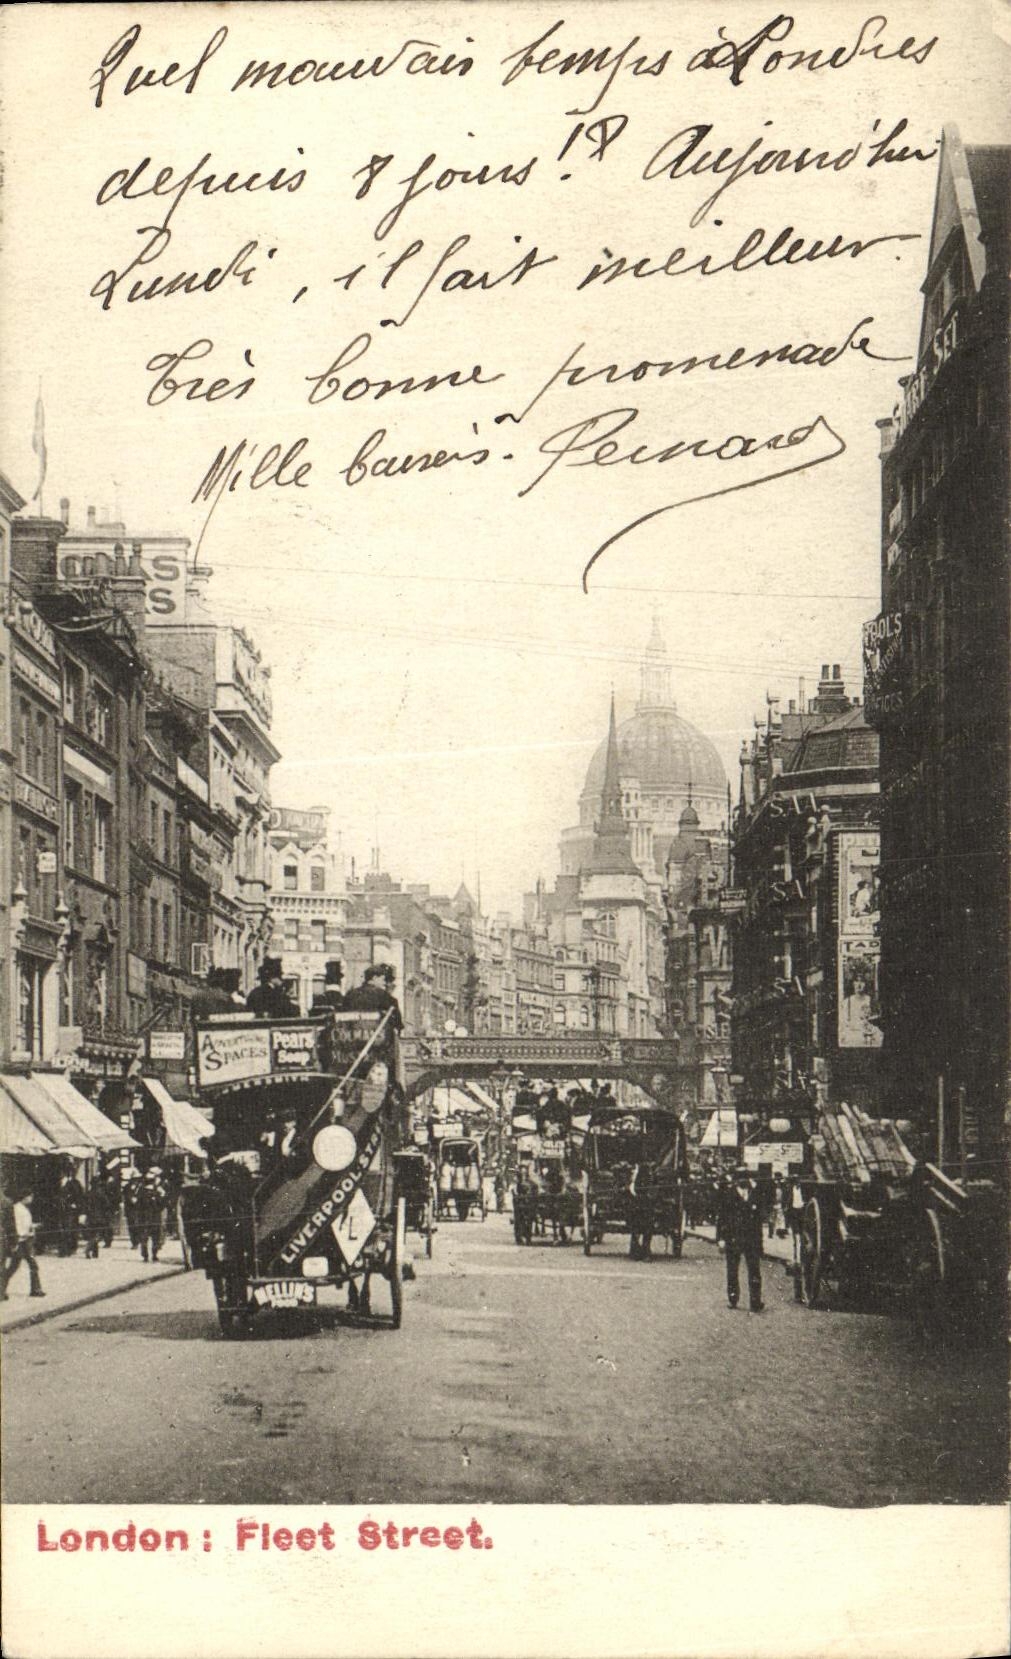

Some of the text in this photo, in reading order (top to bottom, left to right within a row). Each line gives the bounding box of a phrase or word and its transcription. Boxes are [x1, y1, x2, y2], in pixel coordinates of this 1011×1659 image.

[89, 24, 229, 108] Quel
[231, 36, 475, 92] mauvais
[502, 20, 673, 116] temps
[97, 146, 308, 230] depuis
[333, 233, 424, 290] il
[379, 234, 562, 327] fait
[305, 333, 506, 404] bonne
[494, 316, 914, 424] promenade
[205, 1046, 268, 1072] SPACES
[281, 1169, 362, 1264] LIVERPOOL
